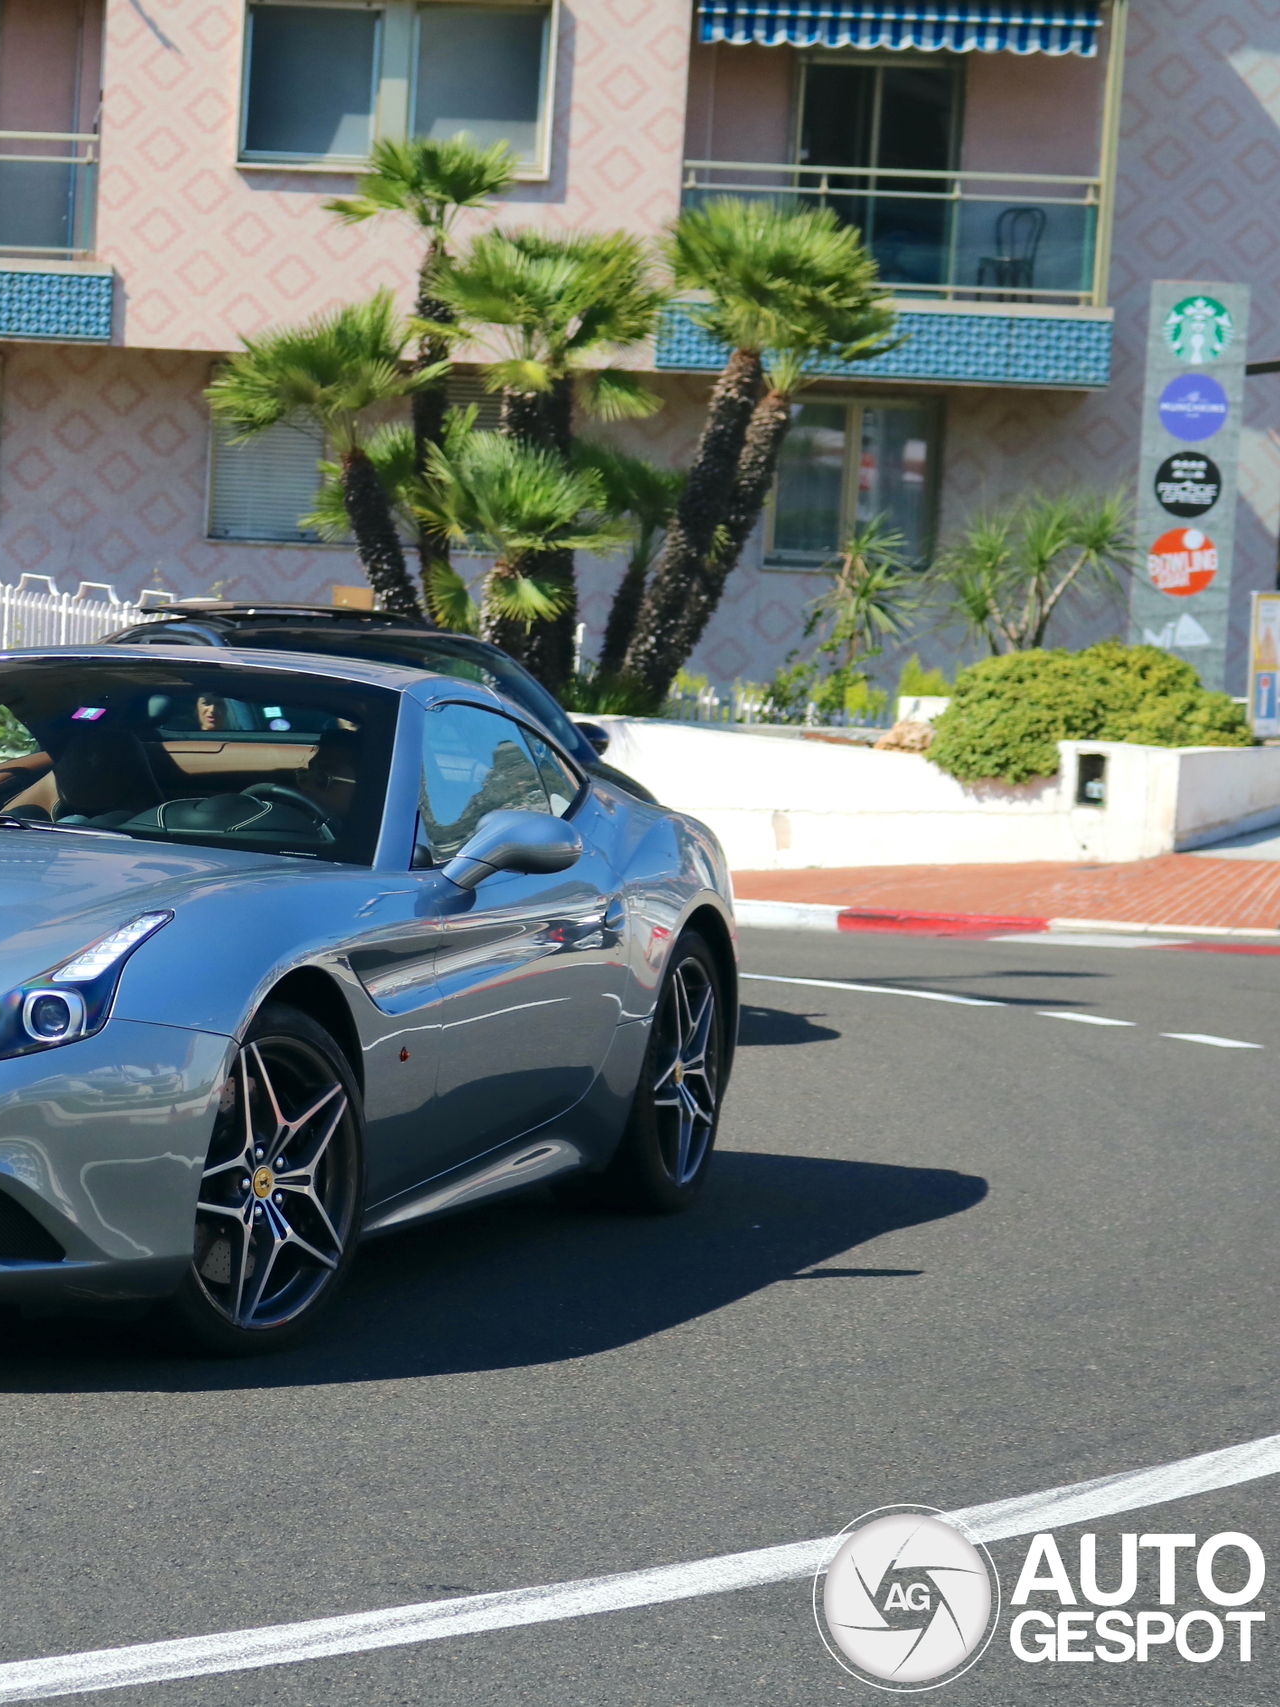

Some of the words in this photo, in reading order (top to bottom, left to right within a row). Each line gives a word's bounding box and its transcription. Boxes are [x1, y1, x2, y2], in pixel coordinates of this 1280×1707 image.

[1157, 481, 1218, 496] ARCADE
[1161, 492, 1213, 505] GAMES
[1147, 549, 1218, 576] BOWLING
